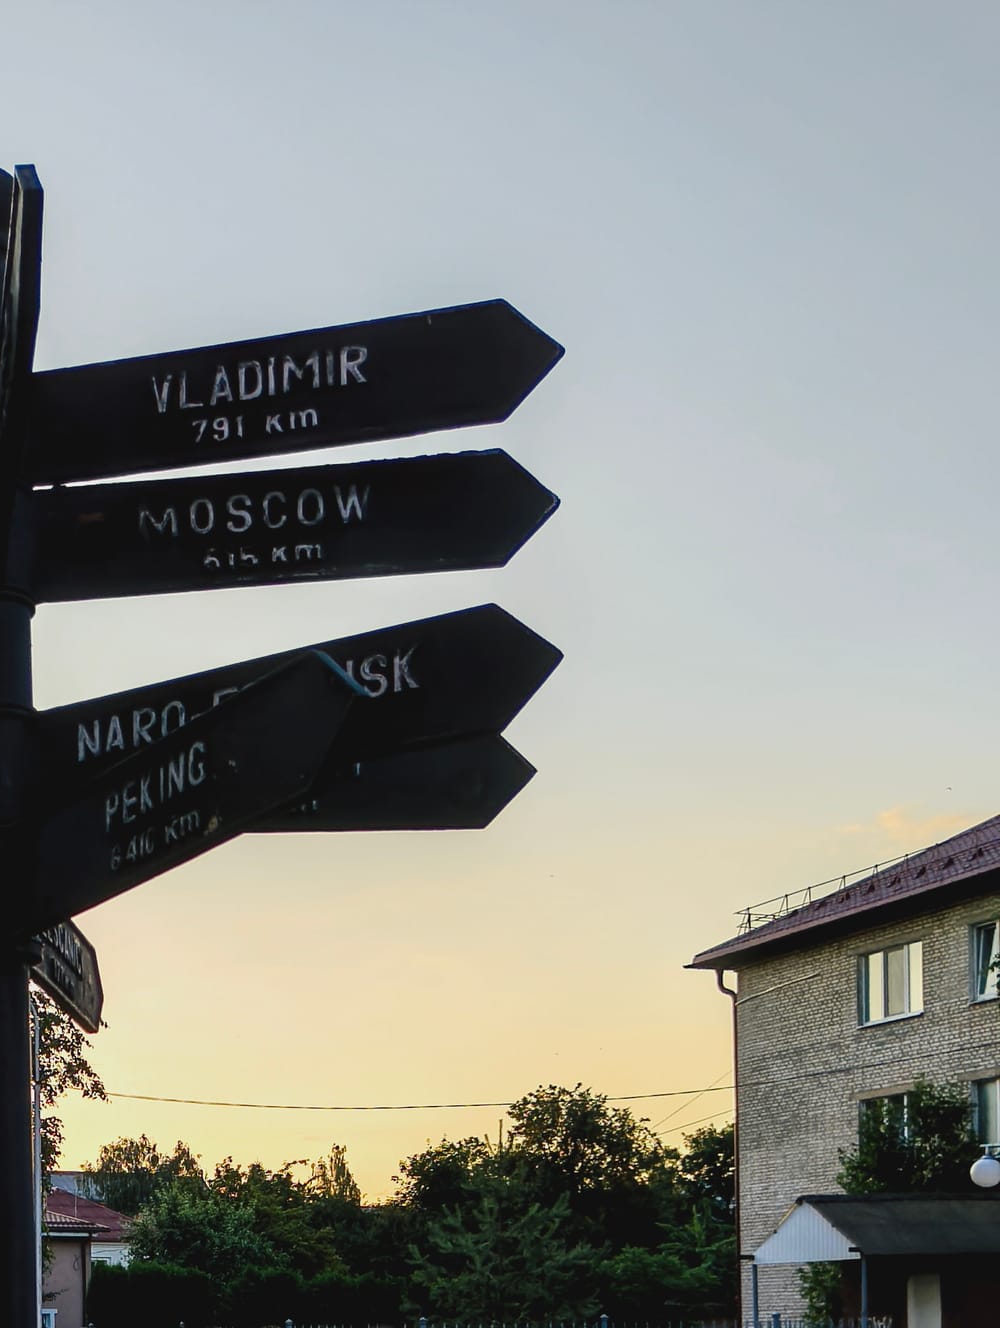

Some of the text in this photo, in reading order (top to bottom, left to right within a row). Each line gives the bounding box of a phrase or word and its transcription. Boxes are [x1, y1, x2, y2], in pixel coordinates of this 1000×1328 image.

[151, 345, 369, 415] VLADIMIR
[191, 414, 245, 443] 791
[138, 483, 370, 538] MOSCOW
[105, 740, 206, 833] PEKING
